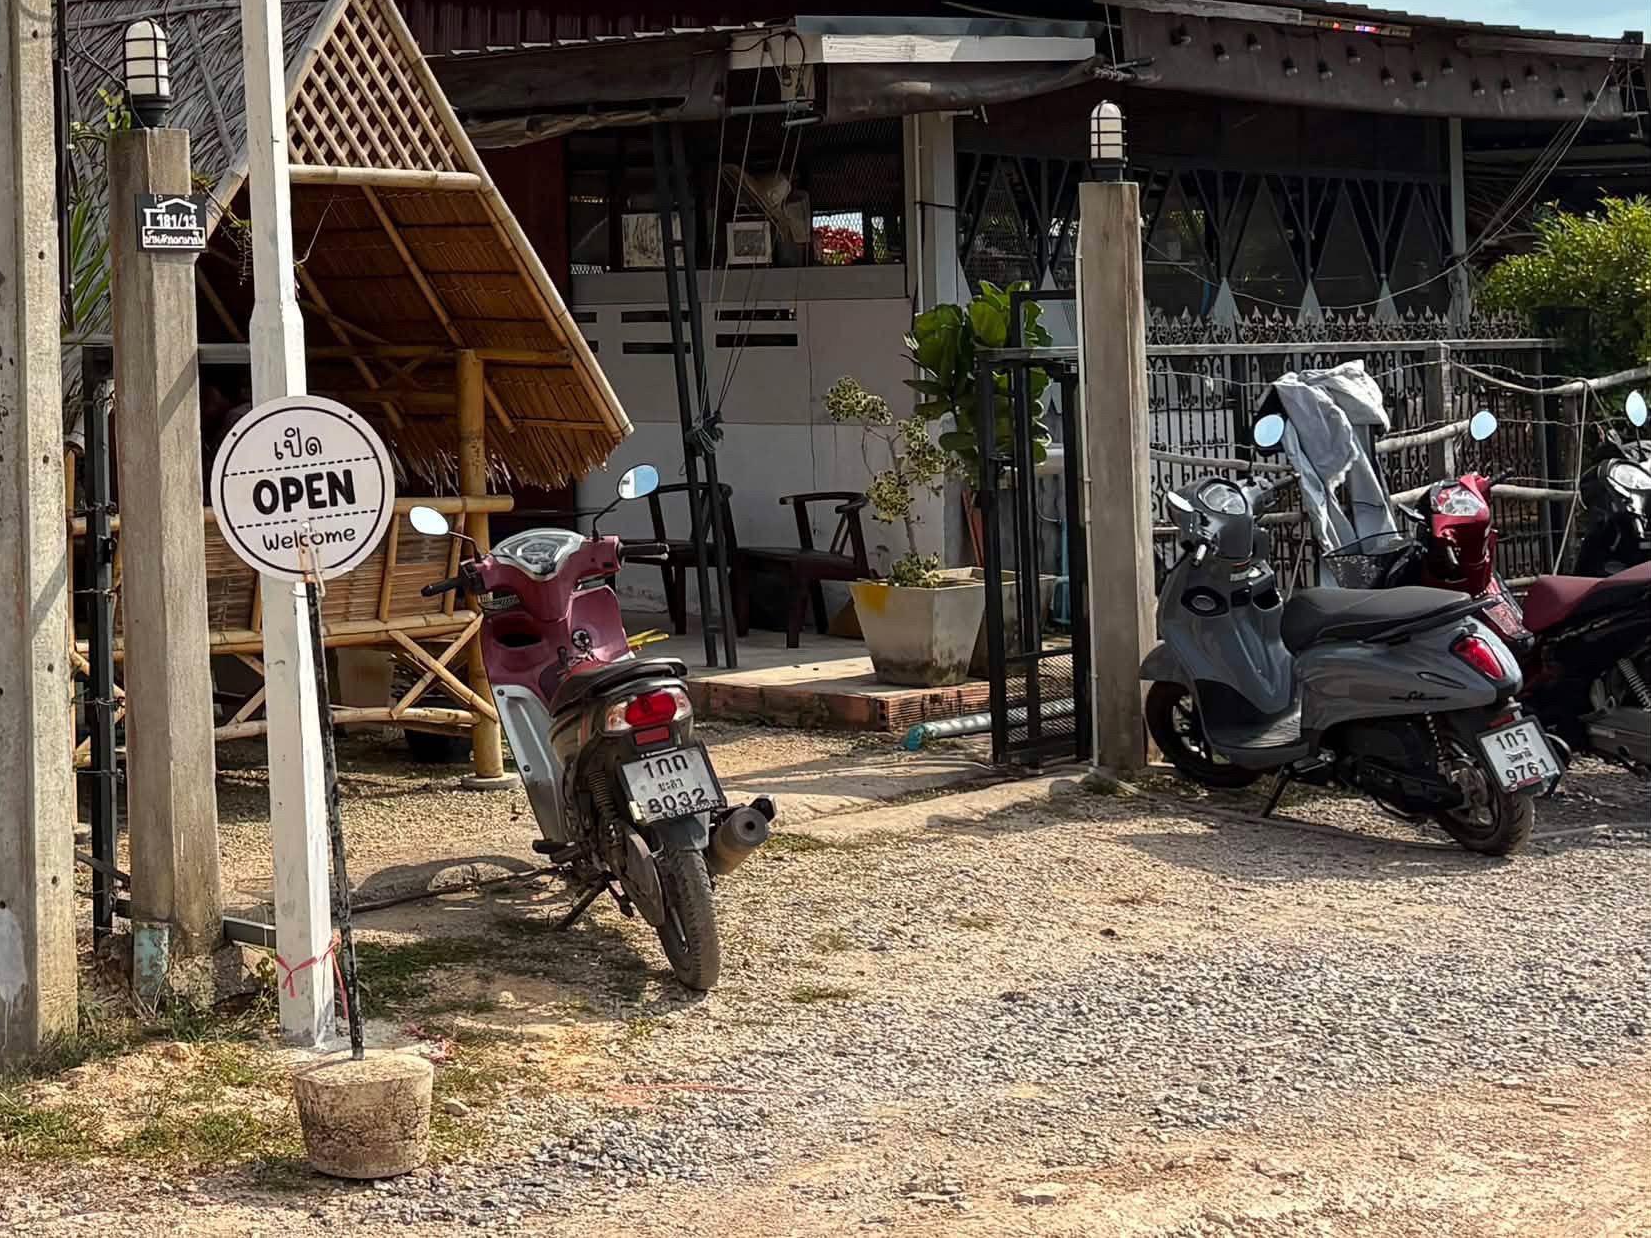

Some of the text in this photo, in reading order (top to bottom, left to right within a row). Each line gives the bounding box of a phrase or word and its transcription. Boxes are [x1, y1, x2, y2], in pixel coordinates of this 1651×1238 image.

[156, 213, 197, 228] 181/13
[274, 427, 323, 460] เปิด
[252, 469, 356, 515] OPEN
[262, 527, 356, 551] Welcome
[1505, 758, 1549, 783] 9761
[648, 787, 708, 814] 8032
